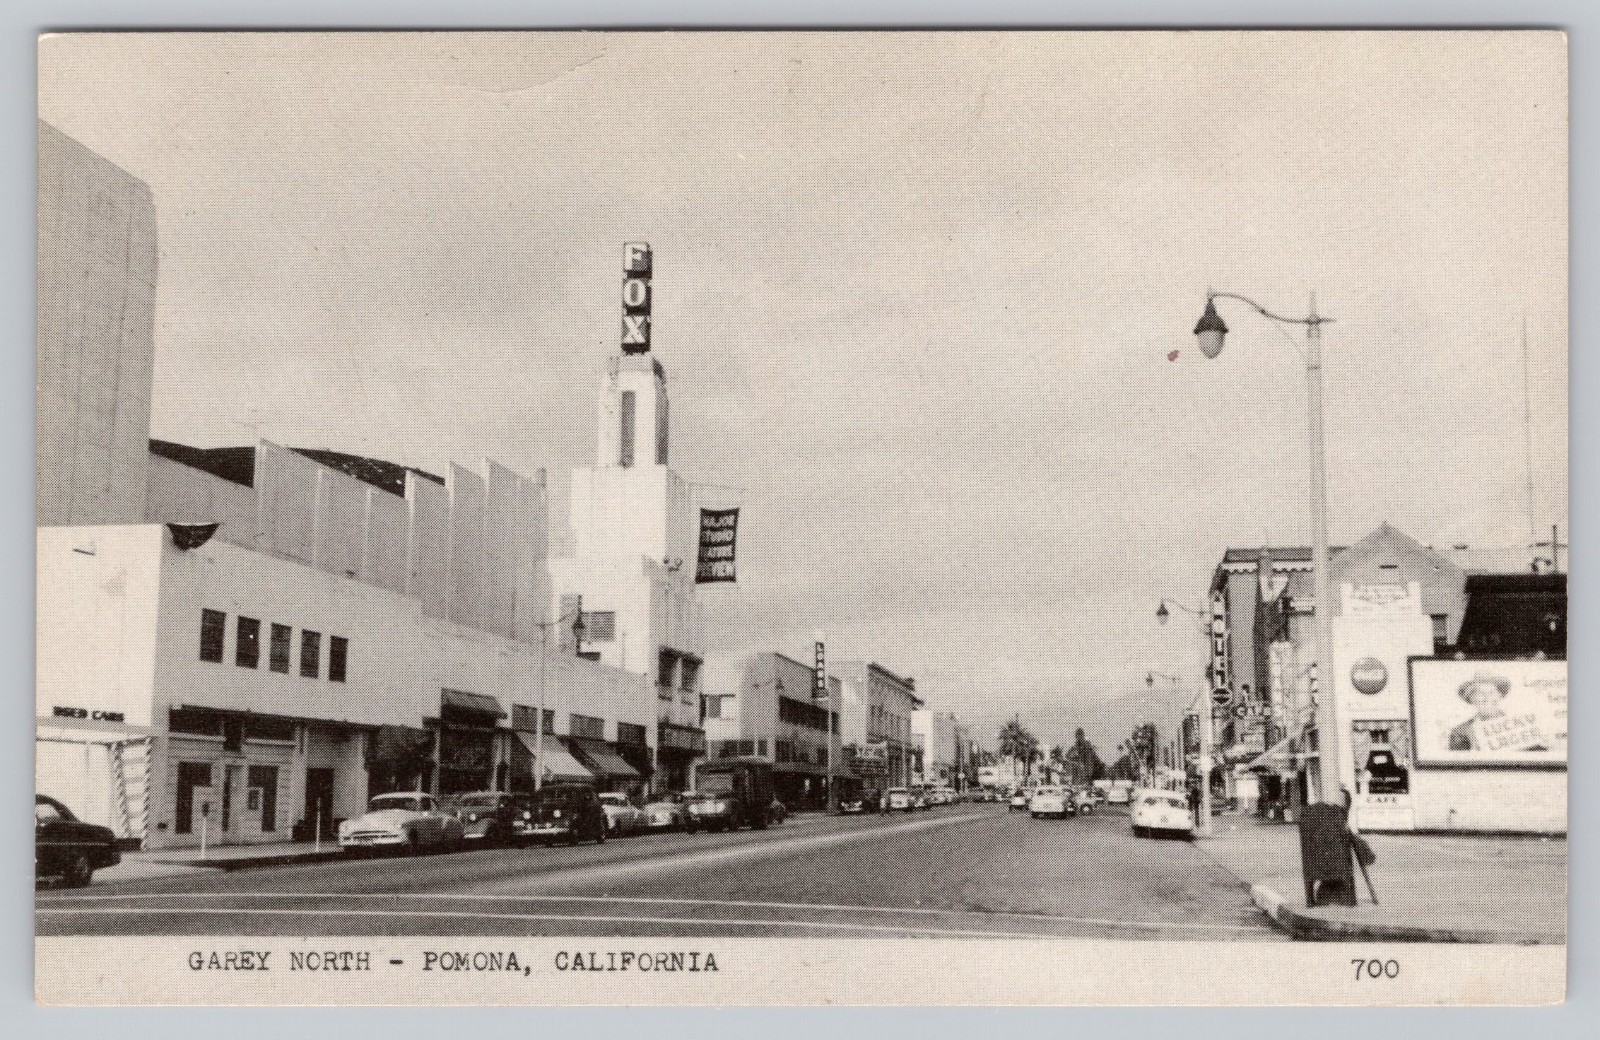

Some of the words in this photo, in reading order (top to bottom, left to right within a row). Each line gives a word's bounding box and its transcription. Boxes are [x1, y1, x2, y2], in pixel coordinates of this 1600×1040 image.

[623, 242, 648, 344] FOX
[53, 706, 88, 719] USED
[92, 710, 125, 722] CARS
[1483, 713, 1536, 737] LUCKY
[1487, 726, 1542, 751] LAGER
[1366, 796, 1397, 804] CAFE
